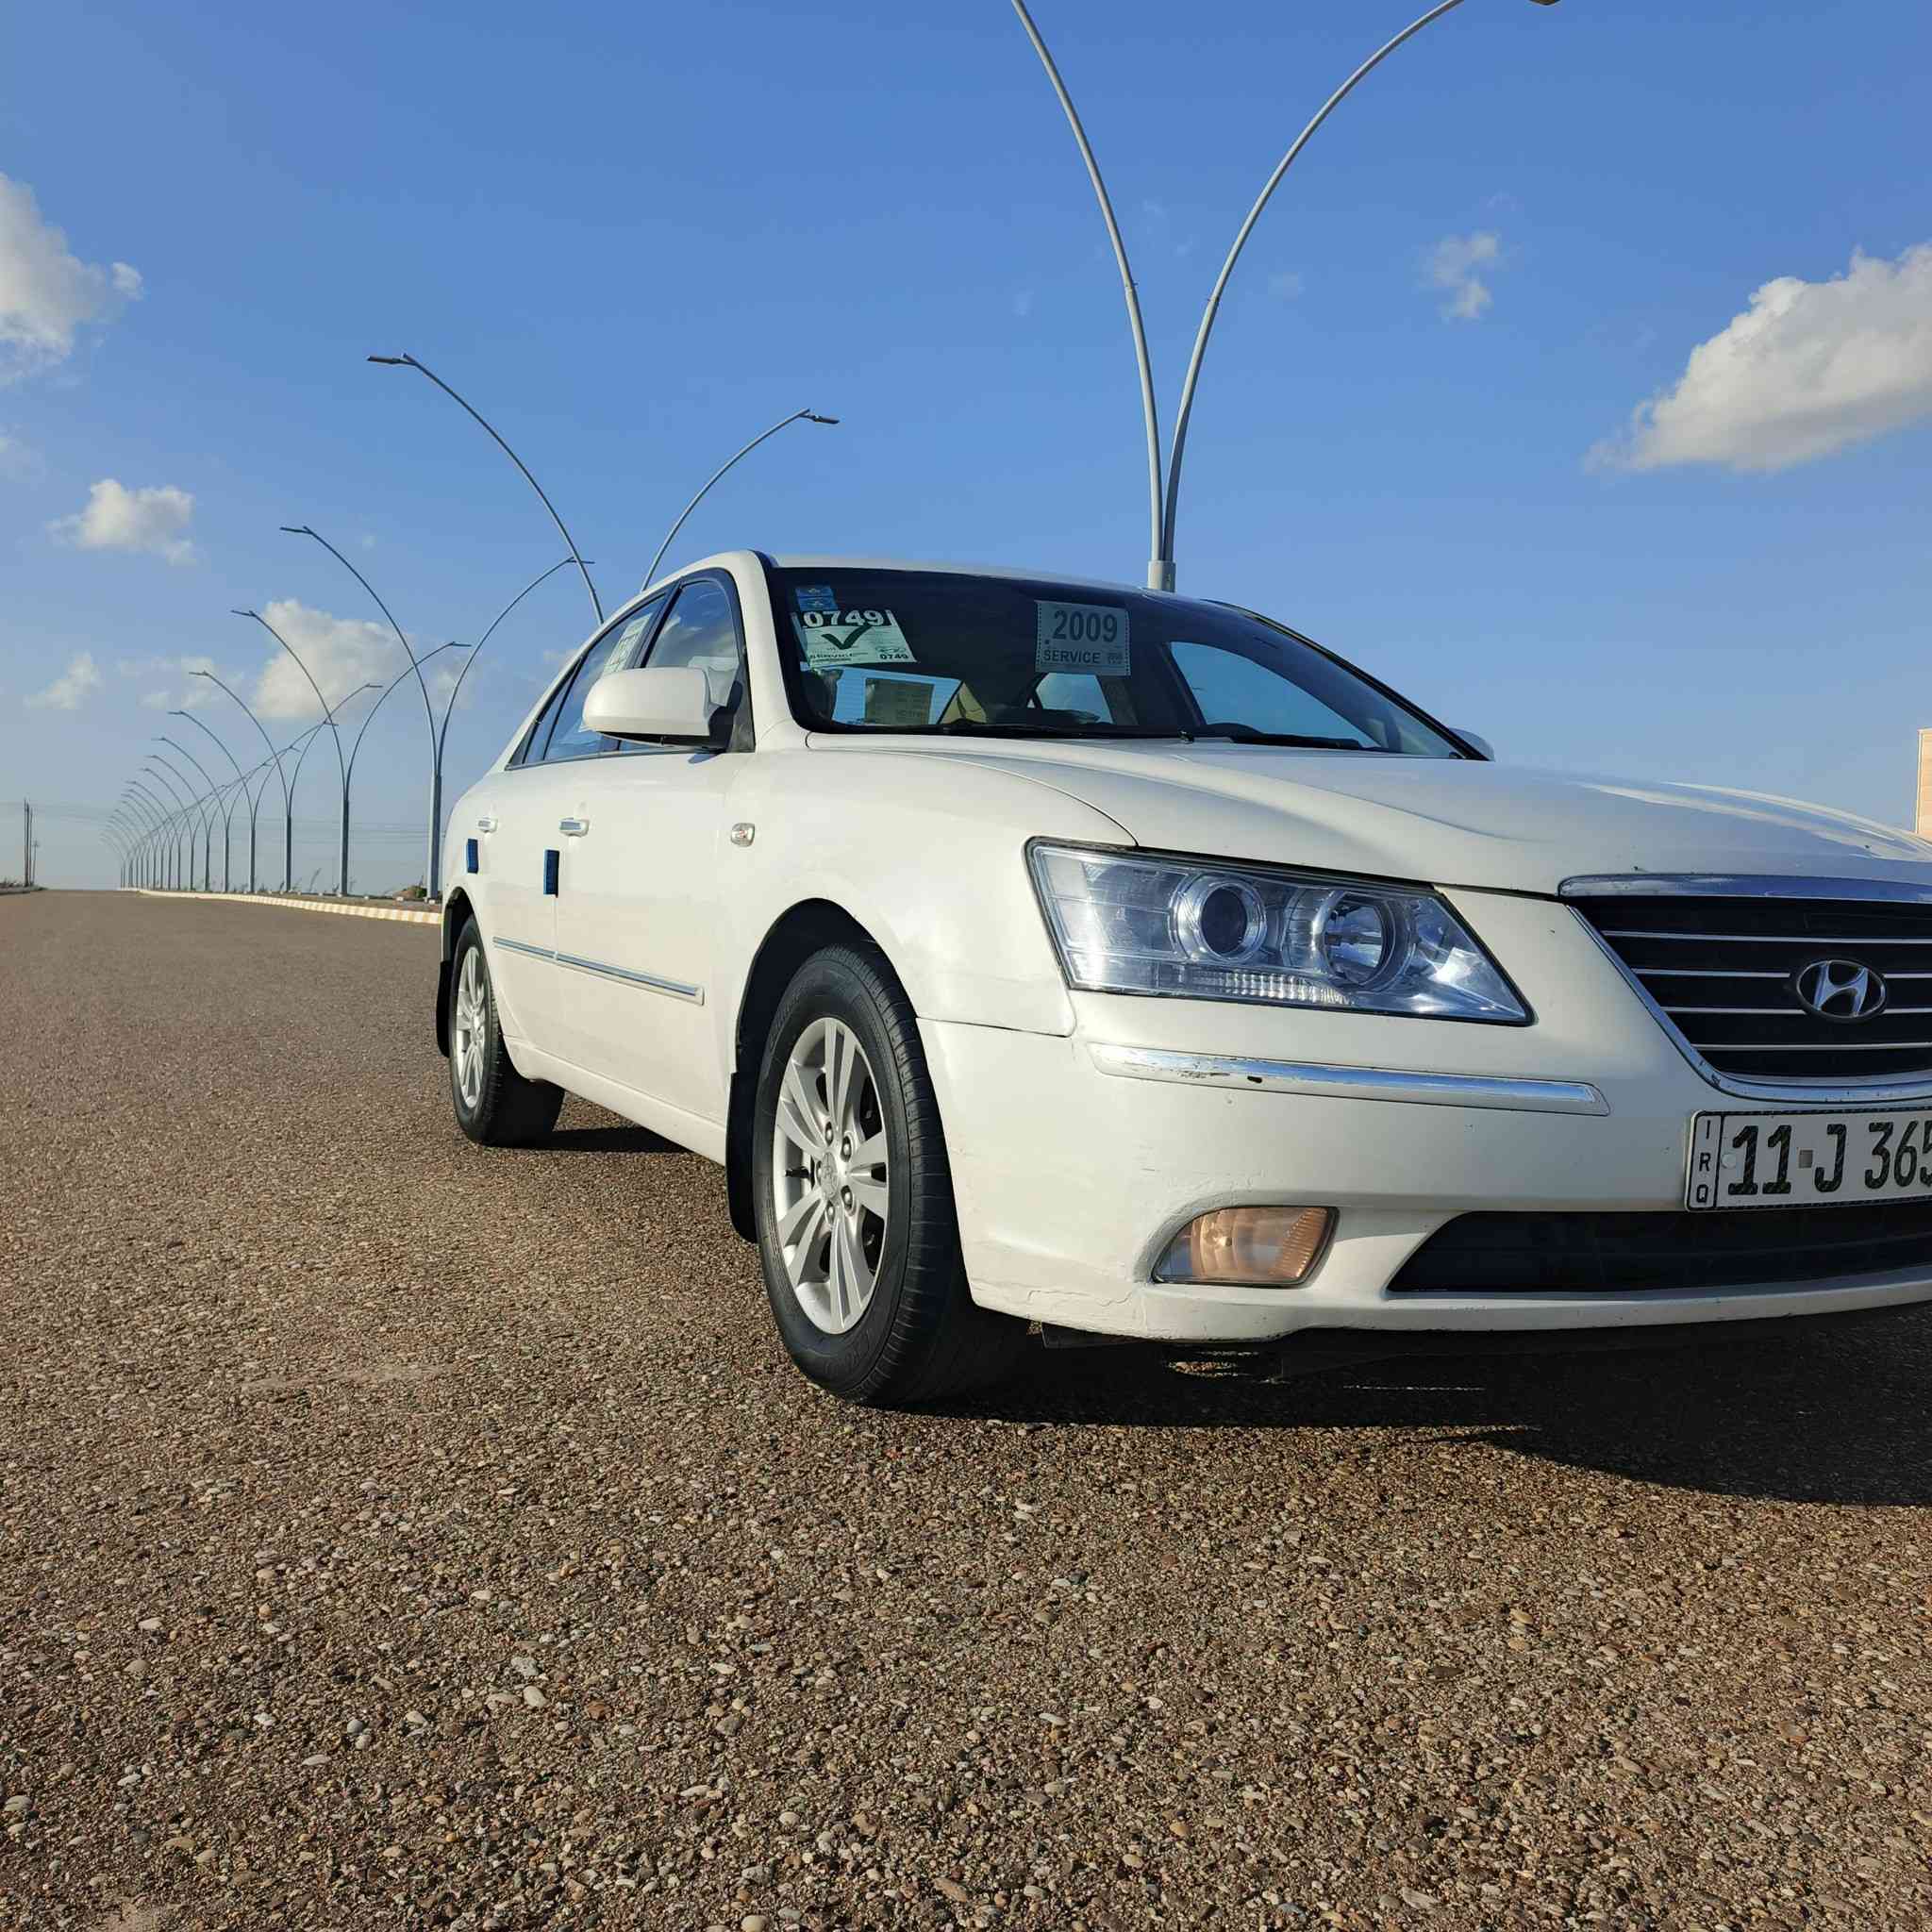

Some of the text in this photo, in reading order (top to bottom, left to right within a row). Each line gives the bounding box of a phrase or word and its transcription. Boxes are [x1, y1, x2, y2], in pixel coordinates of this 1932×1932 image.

[804, 610, 884, 627] 0749
[1053, 610, 1117, 641] 2009
[1043, 650, 1101, 663] SERVICE
[1728, 1125, 1791, 1195] 11
[1814, 1124, 1847, 1192] J
